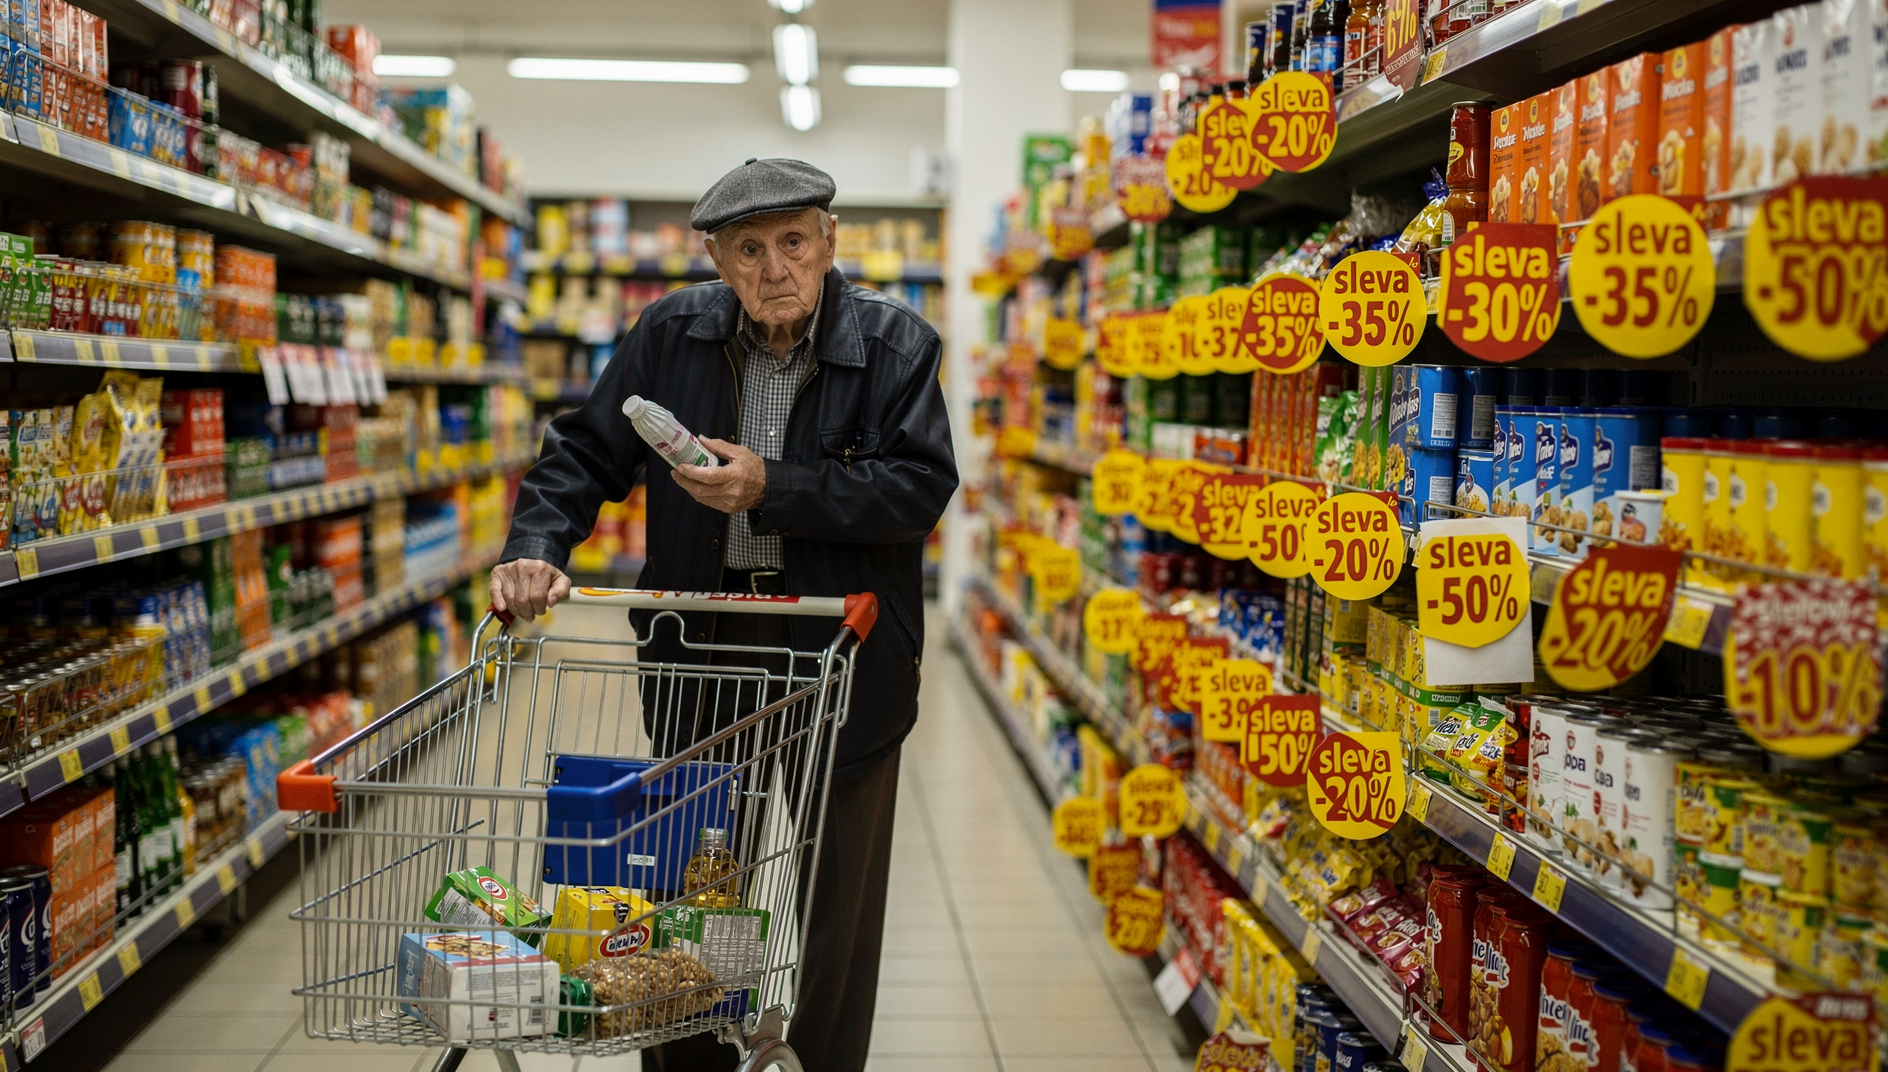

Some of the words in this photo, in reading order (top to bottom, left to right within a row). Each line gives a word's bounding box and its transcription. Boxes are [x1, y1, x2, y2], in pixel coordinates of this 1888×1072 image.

[1260, 83, 1324, 111] sleva
[1206, 108, 1250, 138] slev
[1257, 113, 1332, 157] -20%
[1595, 211, 1692, 255] sleva
[1768, 185, 1885, 243] sleva
[1334, 262, 1409, 294] sleva
[1454, 234, 1549, 279] sleva
[1207, 296, 1243, 320] slev
[1251, 288, 1316, 316] sleva
[1585, 266, 1698, 328] -35%
[1758, 244, 1888, 333] -50%
[1328, 300, 1415, 347] -35%
[1447, 282, 1553, 343] -30%
[1203, 326, 1249, 358] -37
[1245, 314, 1318, 358] -35%
[1256, 492, 1317, 519] sleva
[1318, 502, 1388, 534] sleva
[1250, 523, 1307, 561] -50
[1314, 538, 1395, 582] -20%
[1430, 536, 1512, 569] sleva
[1427, 573, 1518, 626] -50%
[1568, 556, 1668, 608] sleva
[1550, 606, 1659, 673] -20%
[1210, 668, 1267, 693] sleva
[1740, 644, 1881, 731] -10%
[1250, 703, 1316, 733] sleva
[1319, 741, 1391, 774] sleva
[1315, 775, 1396, 823] -20%
[1749, 1013, 1859, 1062] sleva
